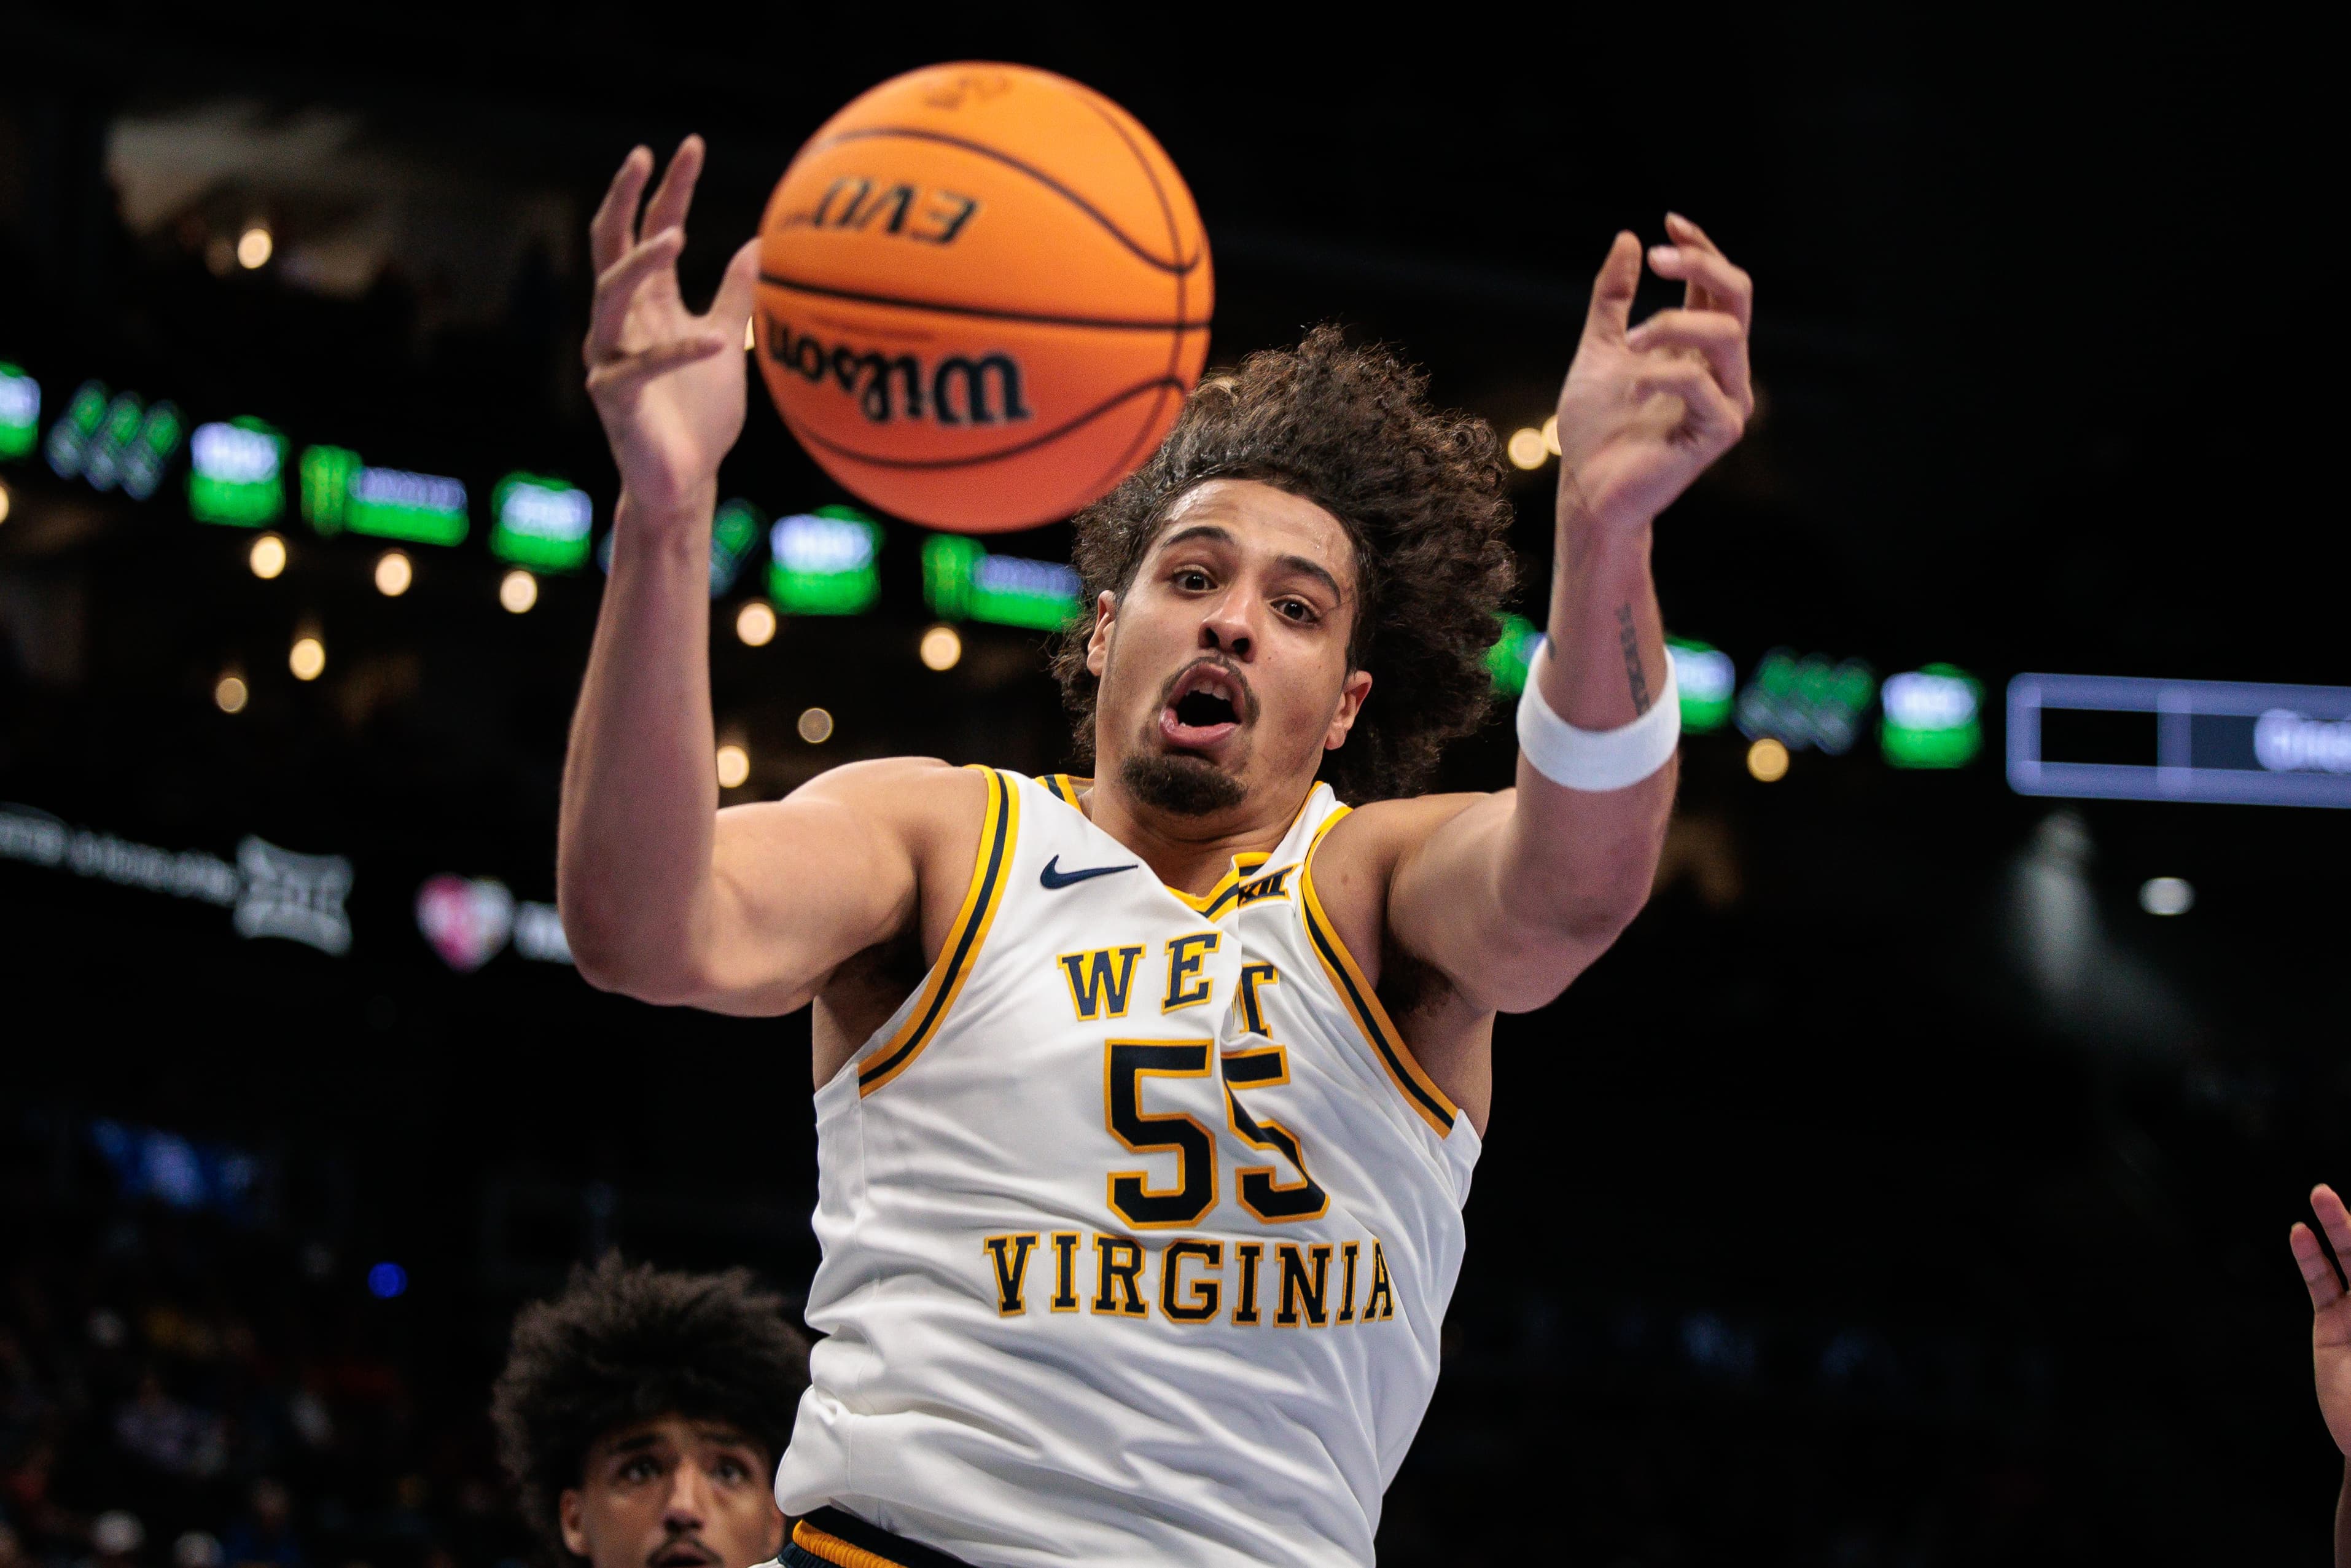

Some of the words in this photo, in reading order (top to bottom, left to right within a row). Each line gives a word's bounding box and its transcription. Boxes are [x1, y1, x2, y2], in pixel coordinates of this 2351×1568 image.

[763, 307, 1034, 426] Wilson
[1056, 930, 1279, 1040] WET
[1104, 1038, 1331, 1230] 55
[984, 1230, 1395, 1328] VIRGINIA
